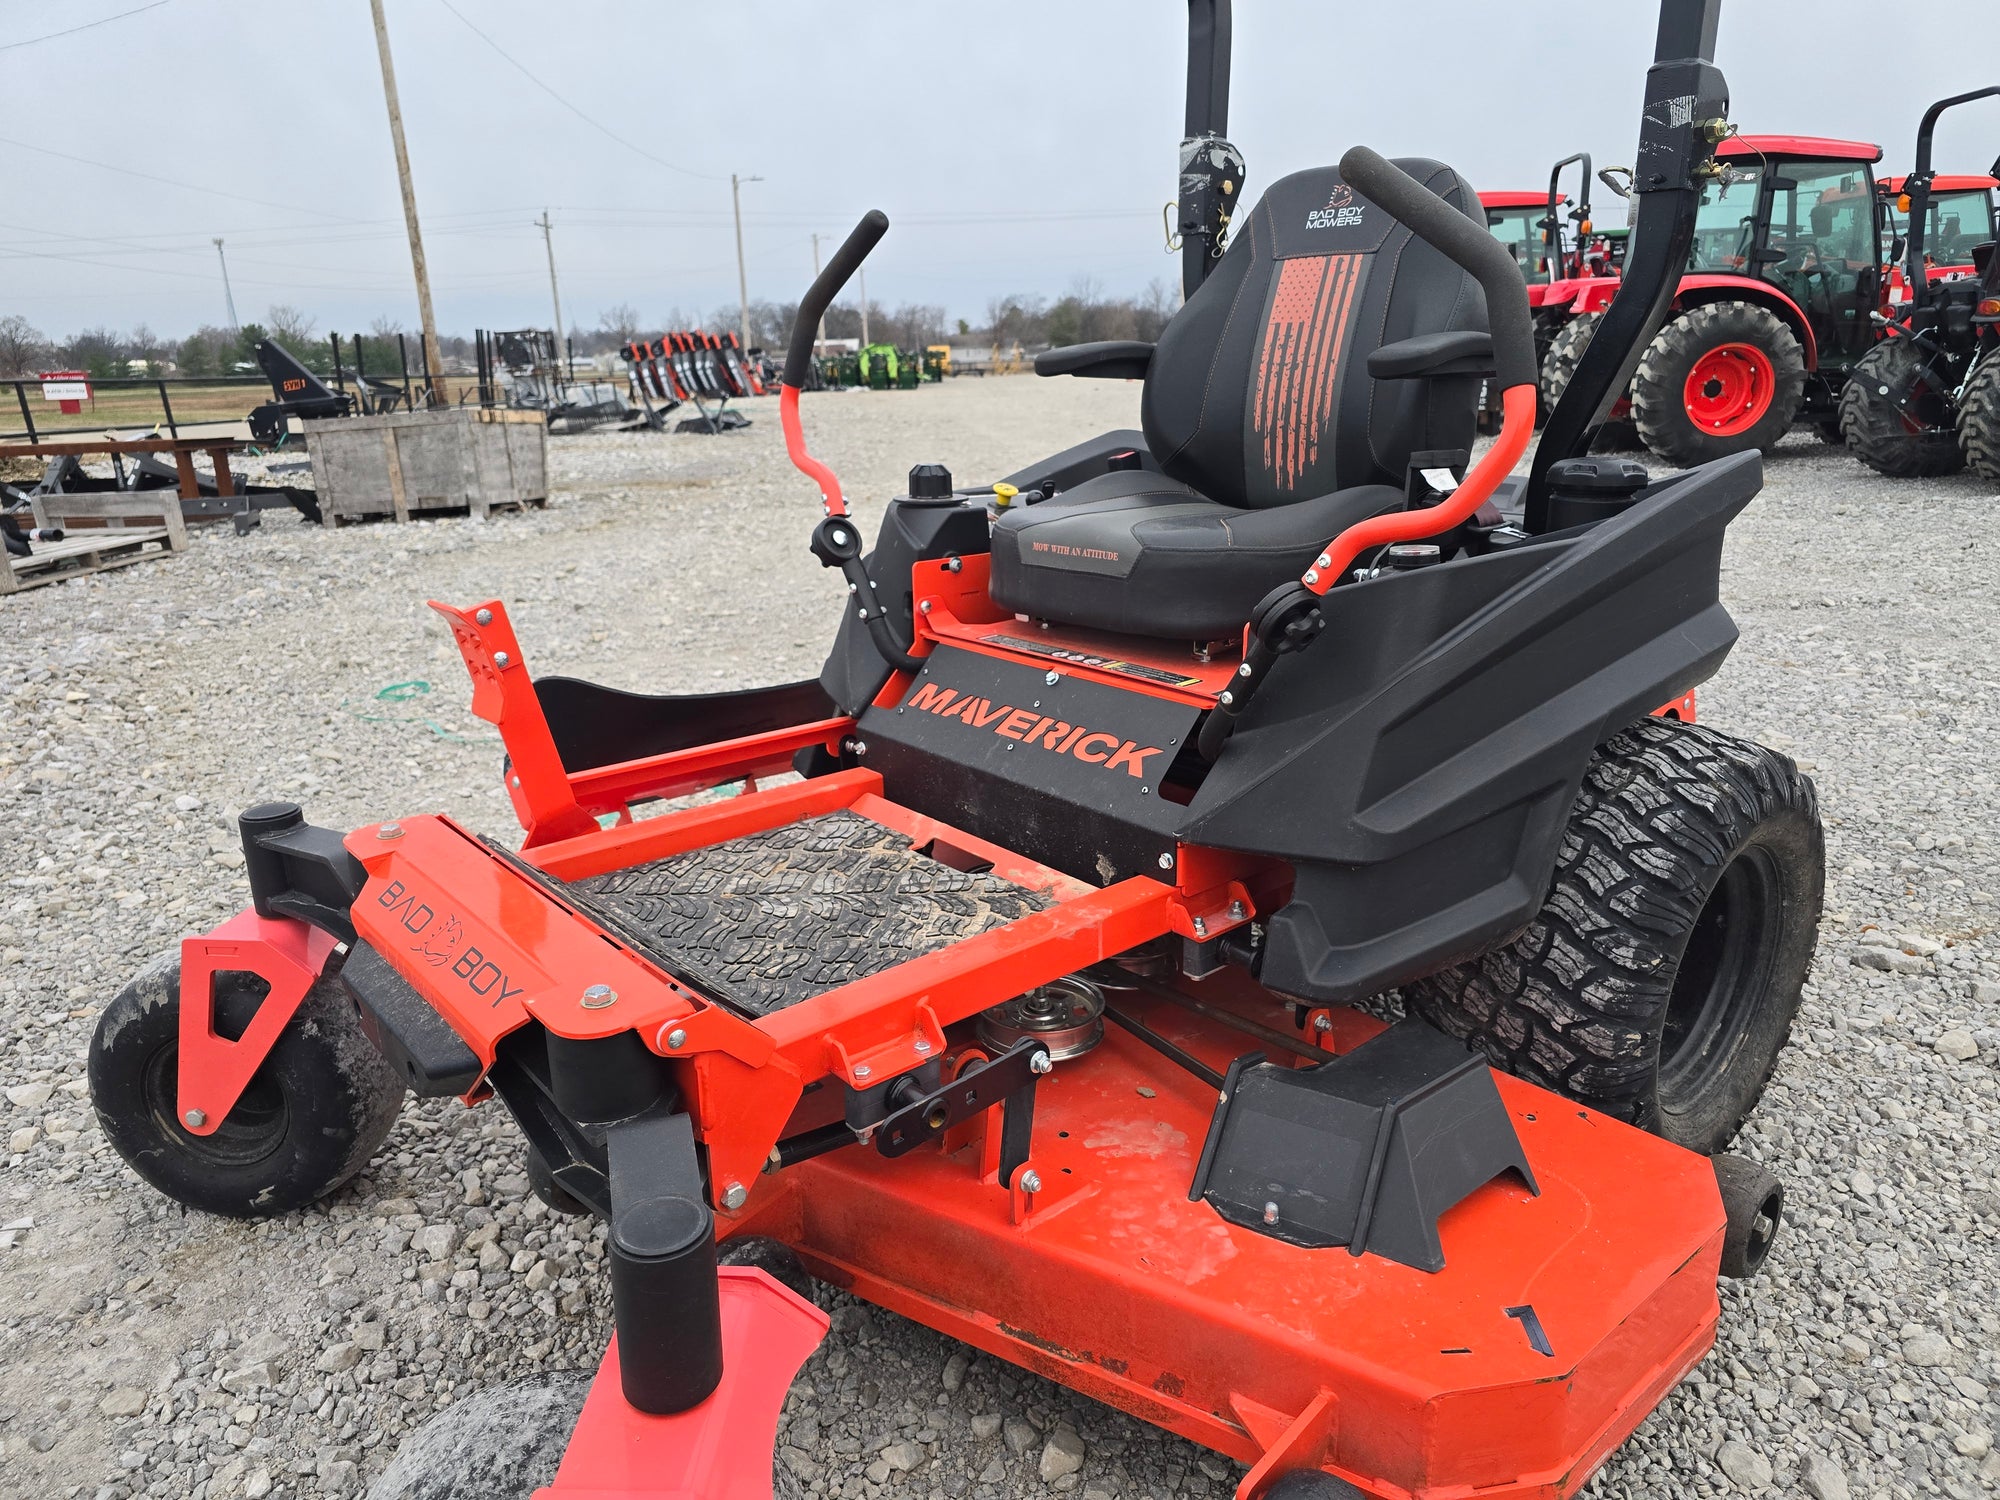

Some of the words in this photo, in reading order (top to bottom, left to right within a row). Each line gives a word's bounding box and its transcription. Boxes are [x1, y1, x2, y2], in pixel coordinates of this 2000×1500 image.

[1305, 216, 1363, 229] MOWERS
[1309, 210, 1335, 220] BAD
[1338, 206, 1365, 217] BOY
[1032, 542, 1049, 552] MOW
[1051, 545, 1070, 555] WITH
[1070, 547, 1082, 557] AN
[1082, 548, 1119, 561] ATTITUDE
[907, 682, 1164, 779] MAVERICK
[377, 880, 435, 935] BAD
[451, 946, 525, 1009] BOY
